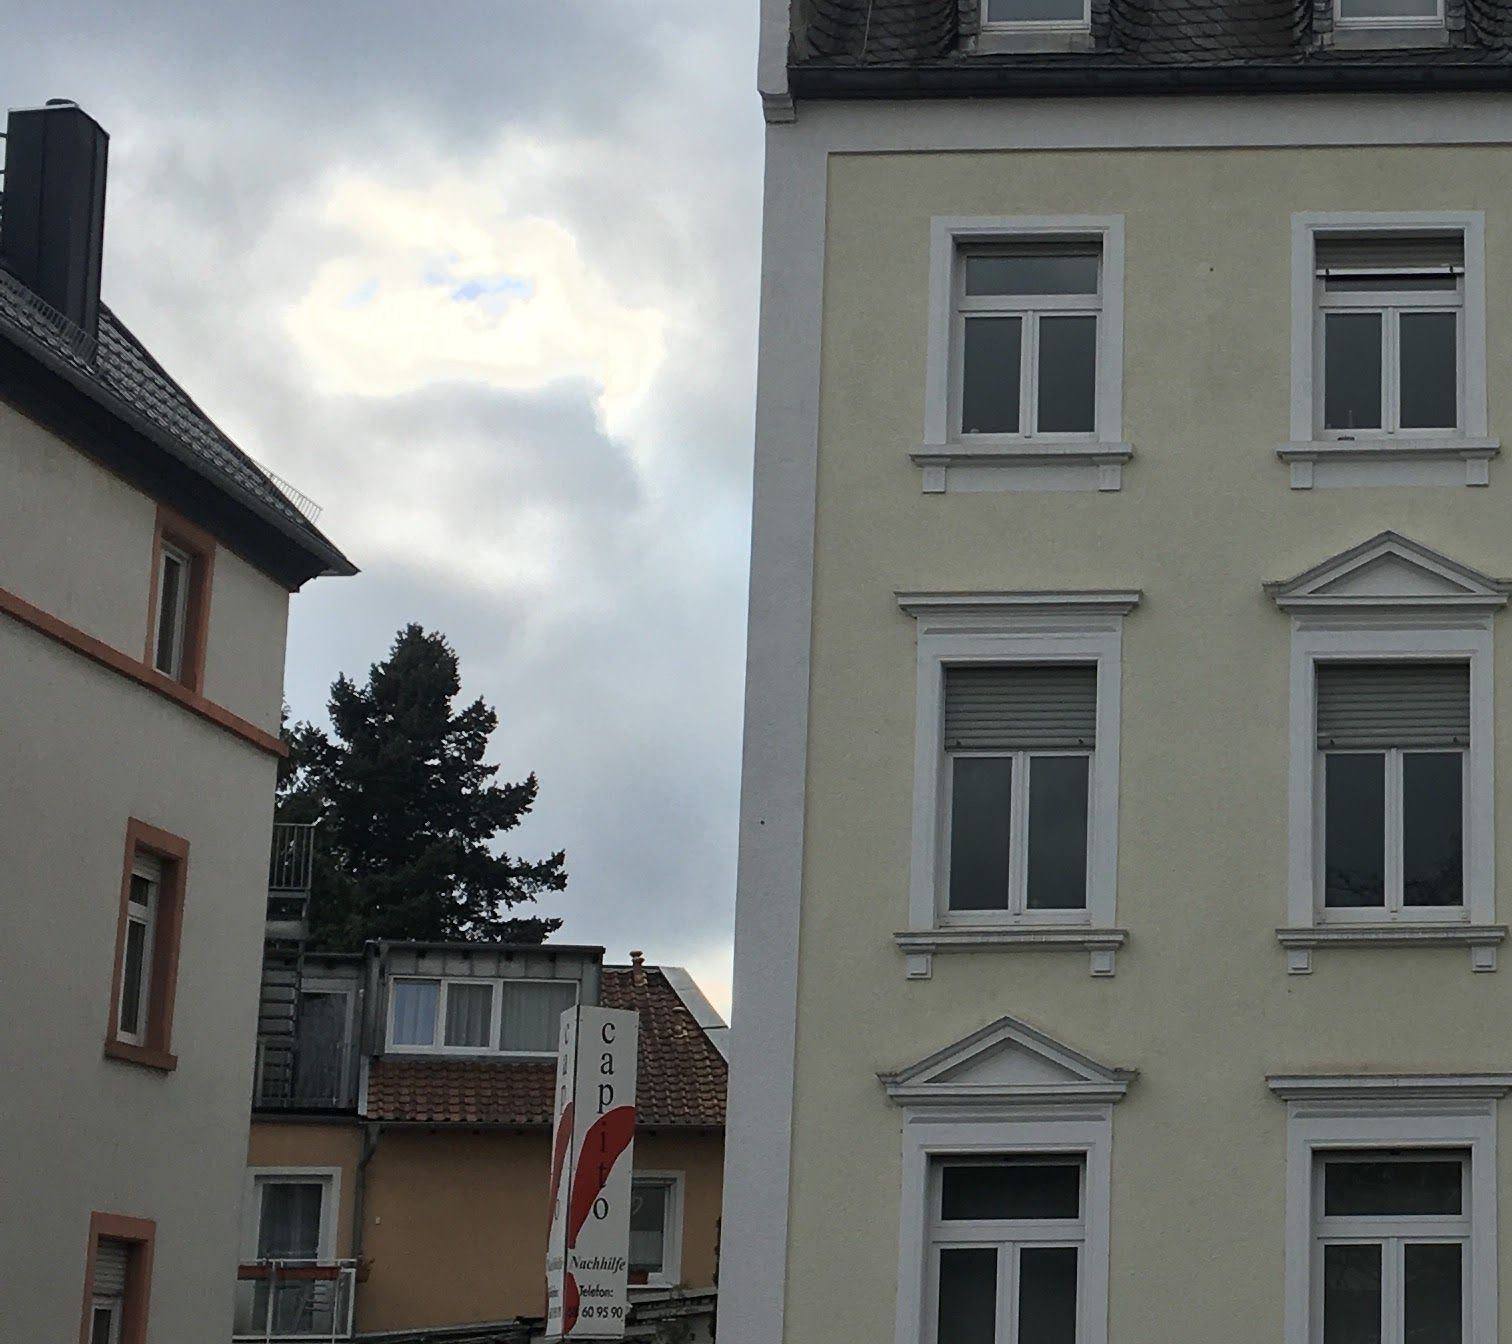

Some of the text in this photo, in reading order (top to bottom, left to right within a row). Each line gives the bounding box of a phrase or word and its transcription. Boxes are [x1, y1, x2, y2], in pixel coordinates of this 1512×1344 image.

[593, 1022, 616, 1220] capito
[571, 1256, 626, 1274] Nachhilfe
[582, 1306, 594, 1318] 60
[596, 1306, 609, 1318] 95
[611, 1306, 623, 1318] 90
